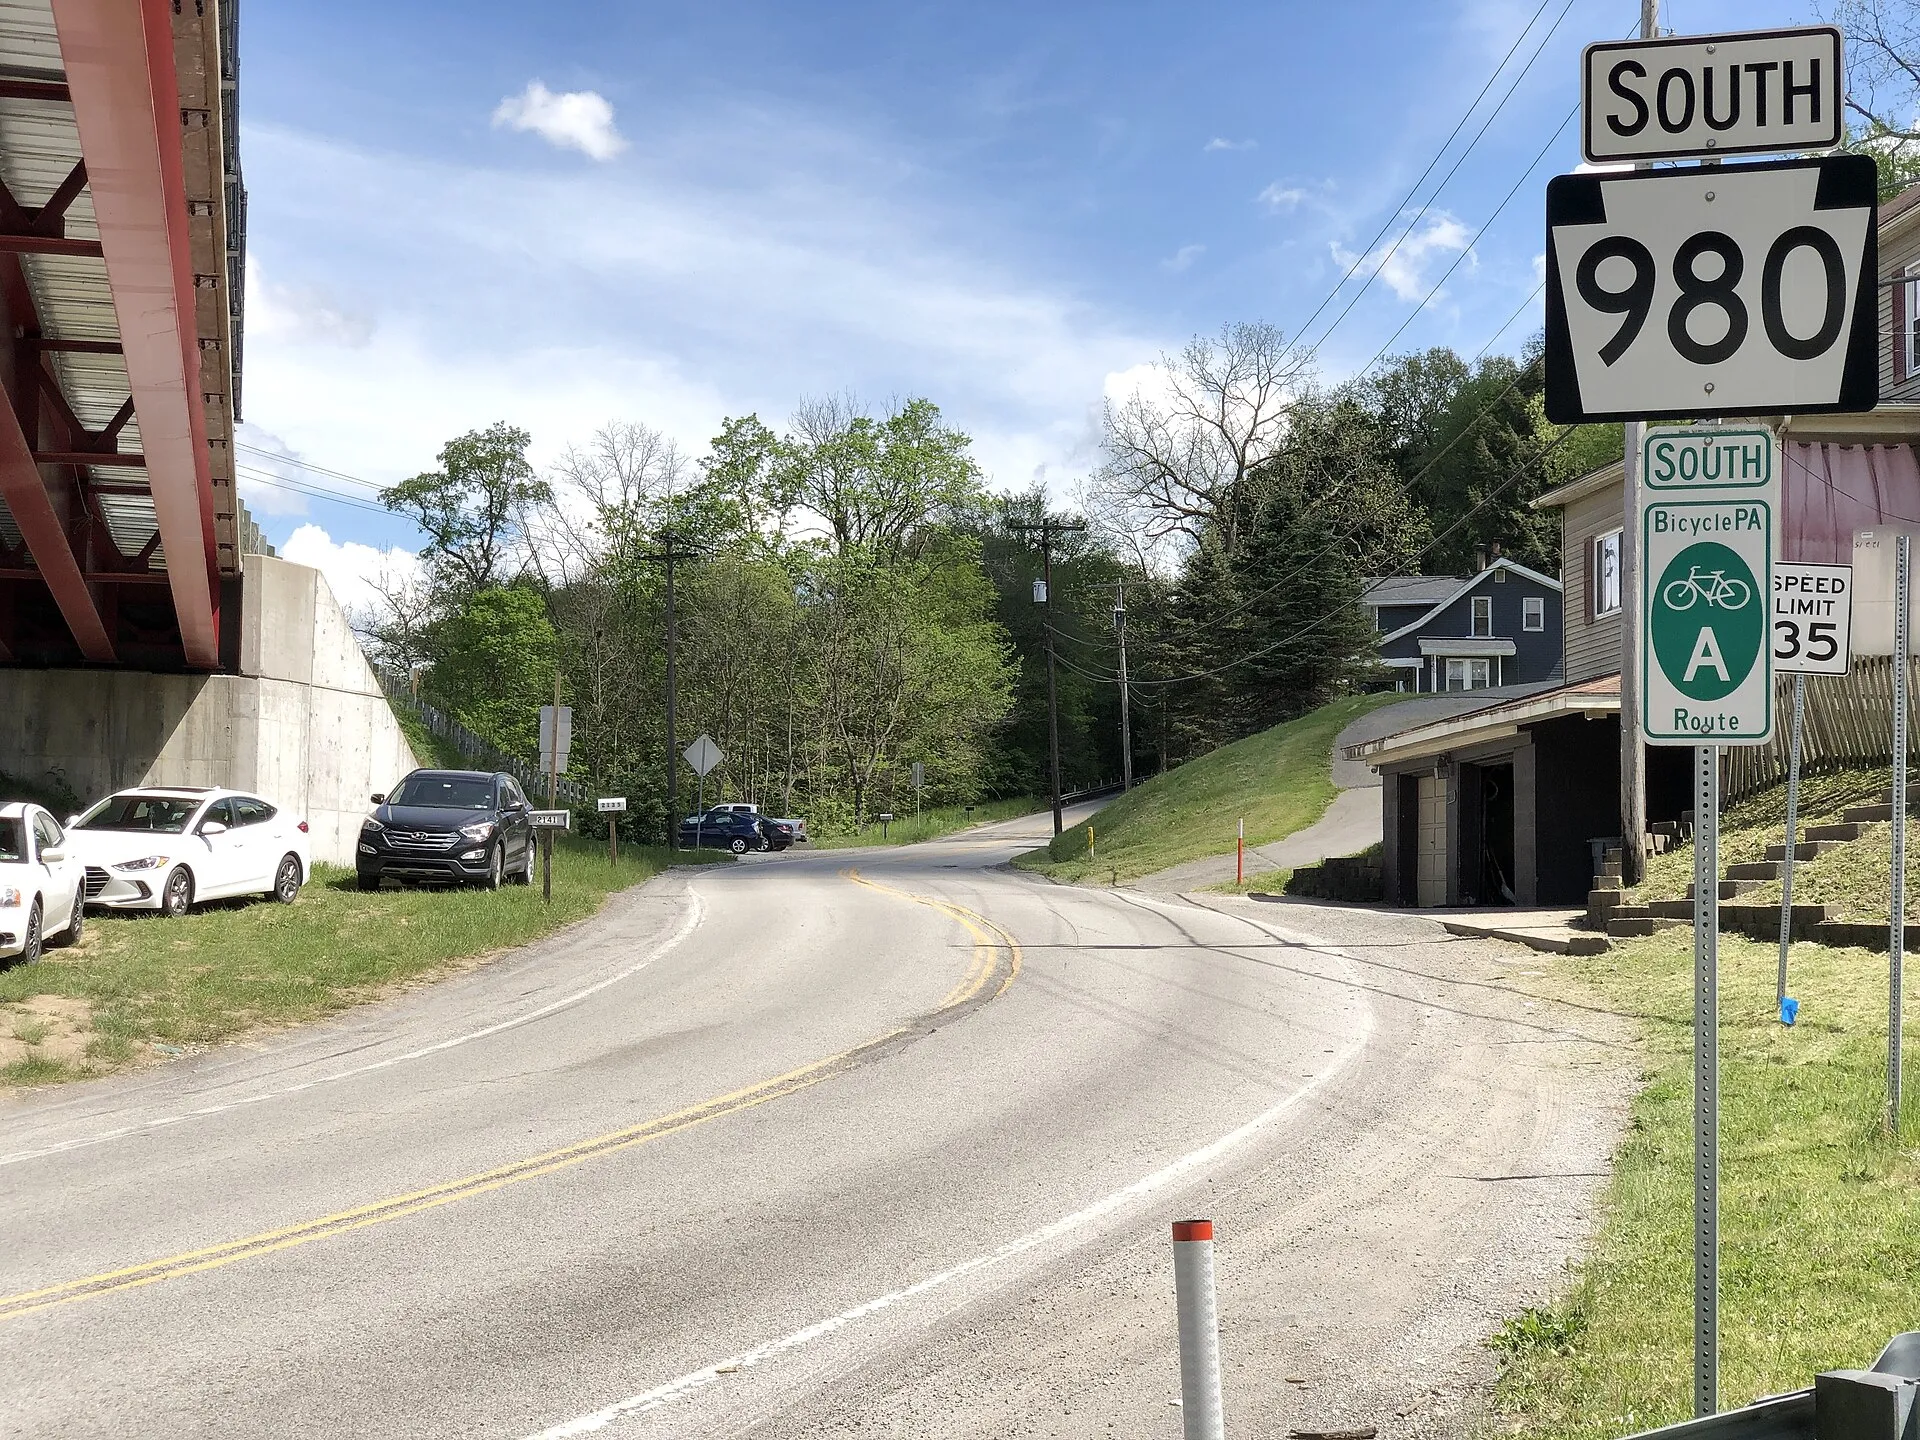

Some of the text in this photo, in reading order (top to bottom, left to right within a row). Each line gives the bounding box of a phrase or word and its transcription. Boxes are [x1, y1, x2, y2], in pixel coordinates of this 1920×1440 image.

[1606, 58, 1821, 137] SOUTH
[1576, 225, 1847, 368] 980
[1654, 442, 1761, 481] SOUTH
[1776, 597, 1835, 616] LIMIT
[1682, 626, 1730, 682] A
[1775, 620, 1838, 662] 35
[1674, 707, 1740, 731] Route
